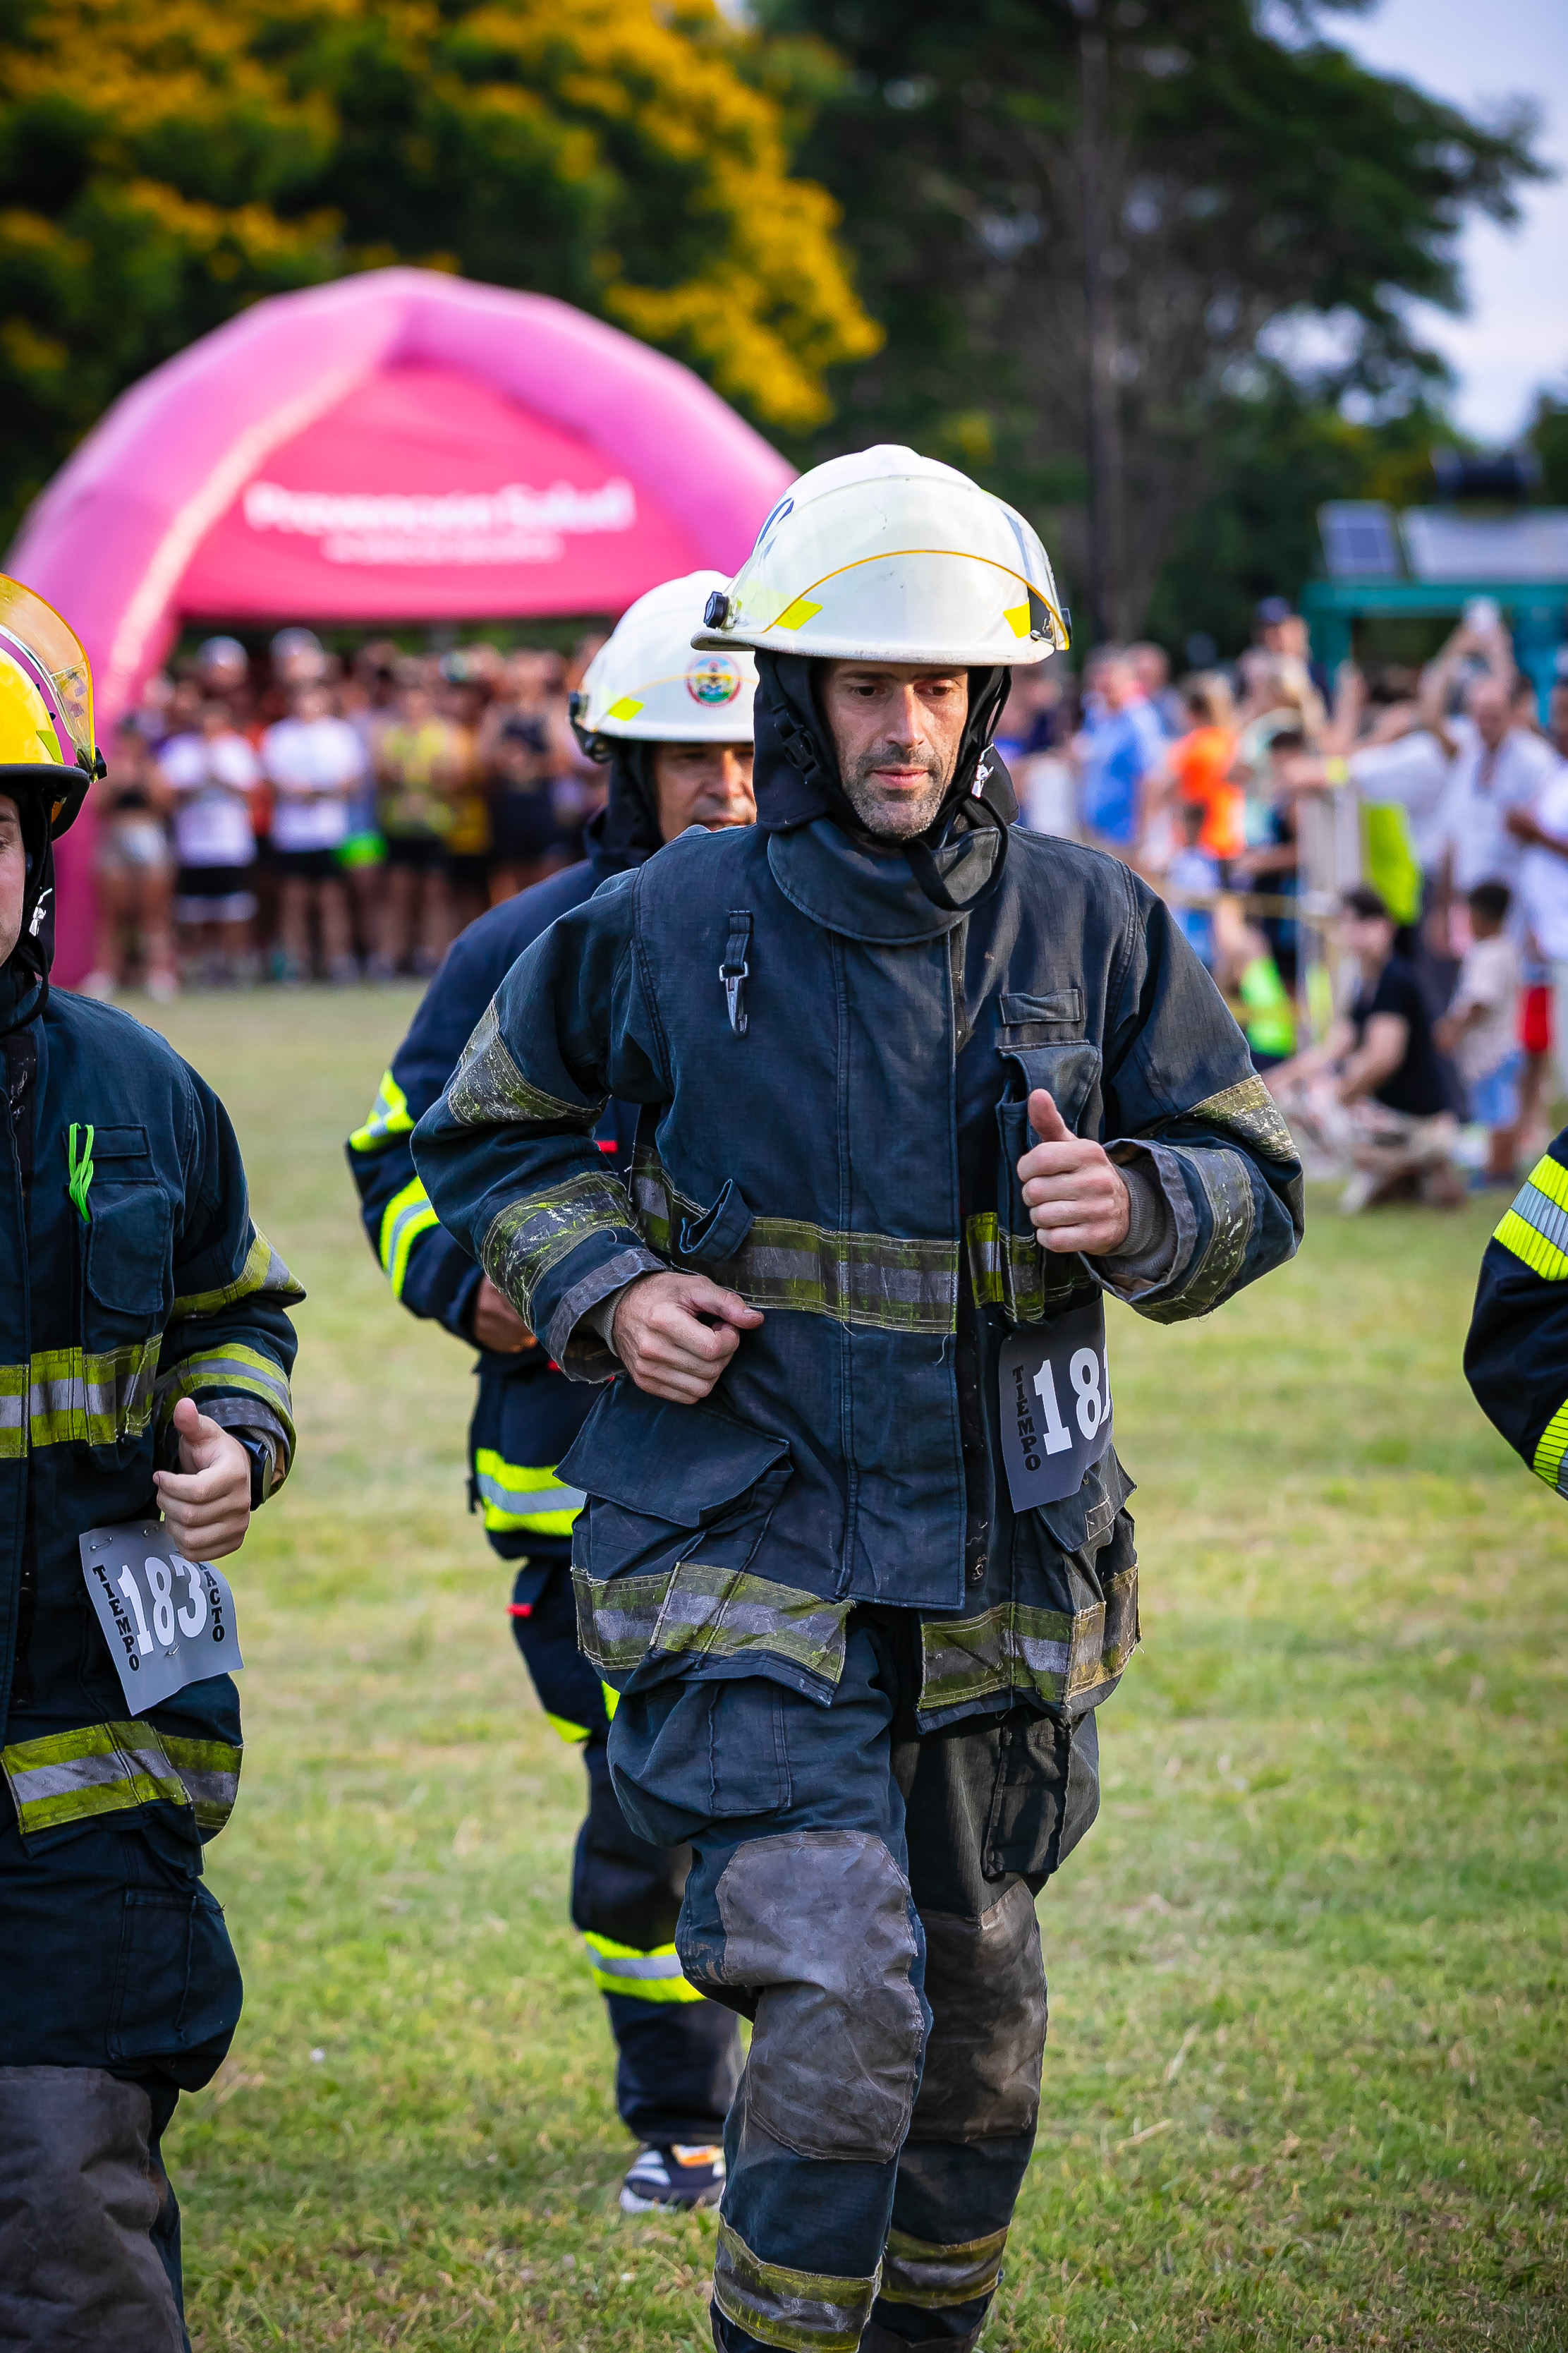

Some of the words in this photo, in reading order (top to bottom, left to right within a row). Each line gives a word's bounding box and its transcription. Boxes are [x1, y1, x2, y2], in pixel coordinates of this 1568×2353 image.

[1011, 1365, 1042, 1472] TIEMPO
[92, 1564, 140, 1671] TIEMPO
[117, 1554, 207, 1656] 183
